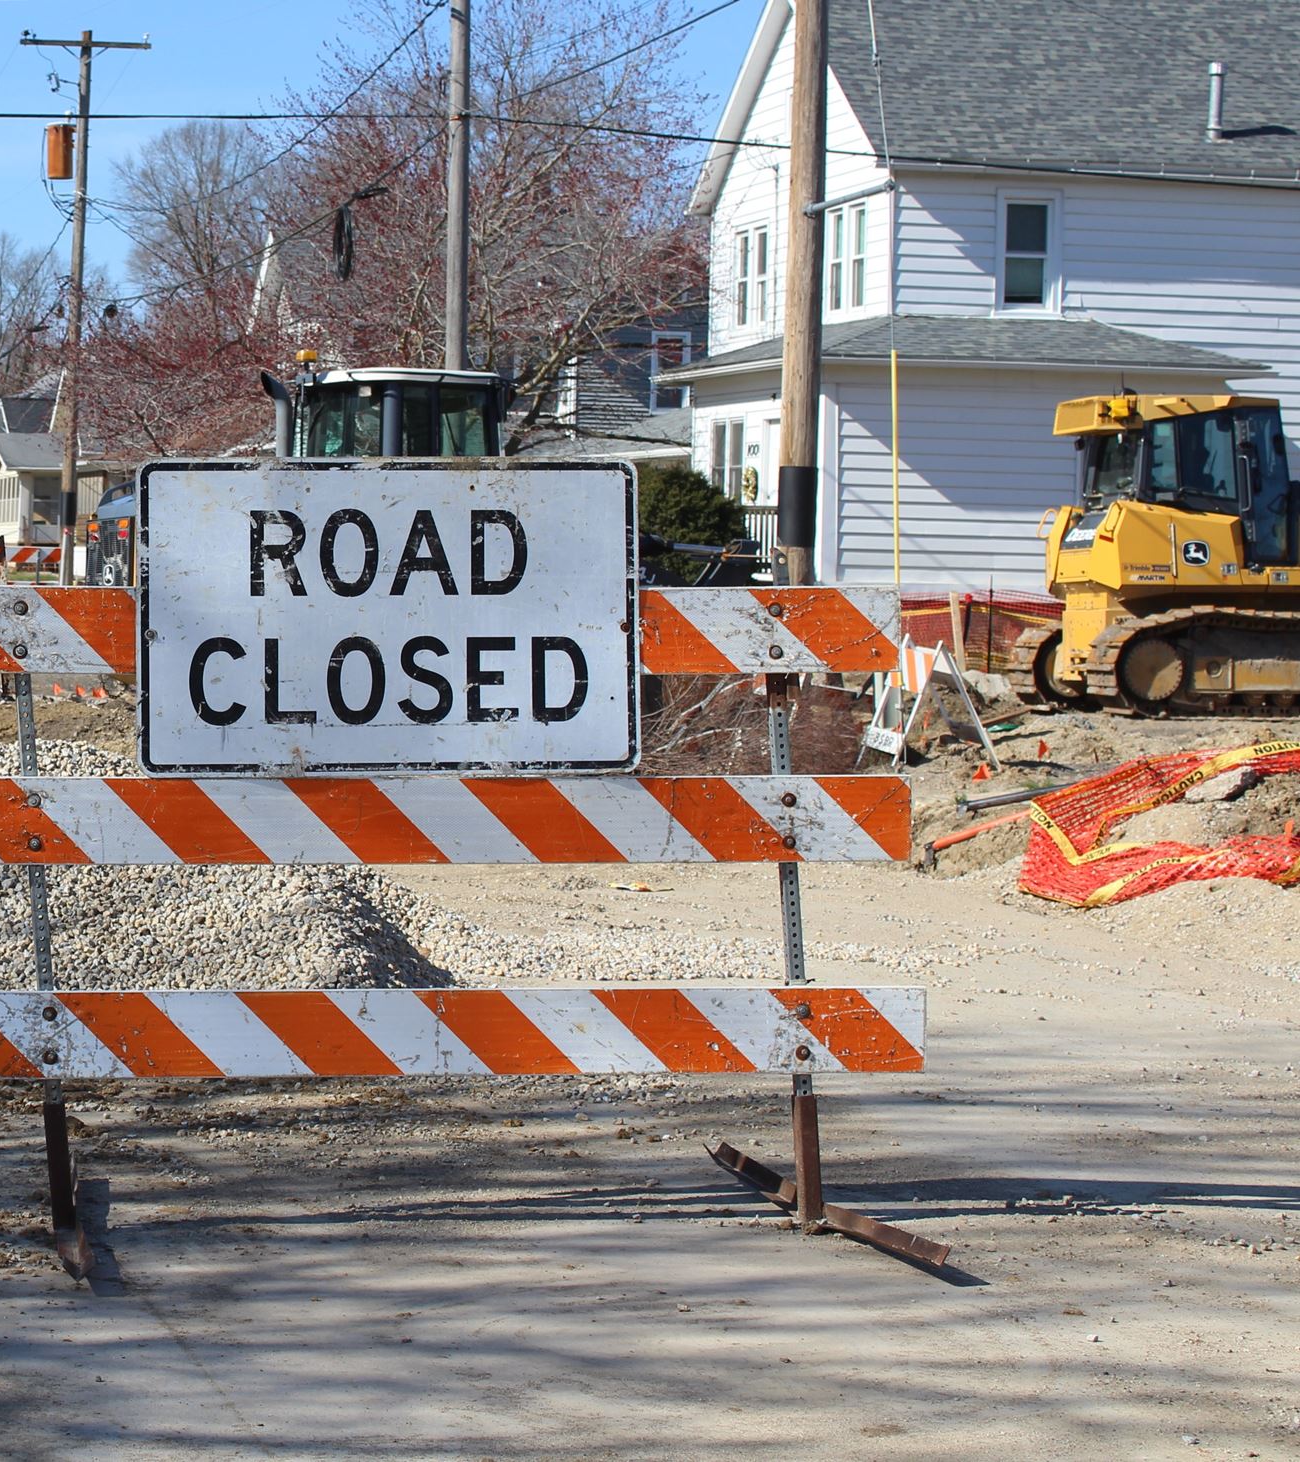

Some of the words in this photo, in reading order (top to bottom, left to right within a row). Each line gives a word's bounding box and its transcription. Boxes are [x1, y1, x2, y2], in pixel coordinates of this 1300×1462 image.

[747, 443, 760, 457] 100
[250, 509, 528, 598] ROAD
[189, 636, 589, 728] CLOSED
[1152, 770, 1204, 807] CAUTION
